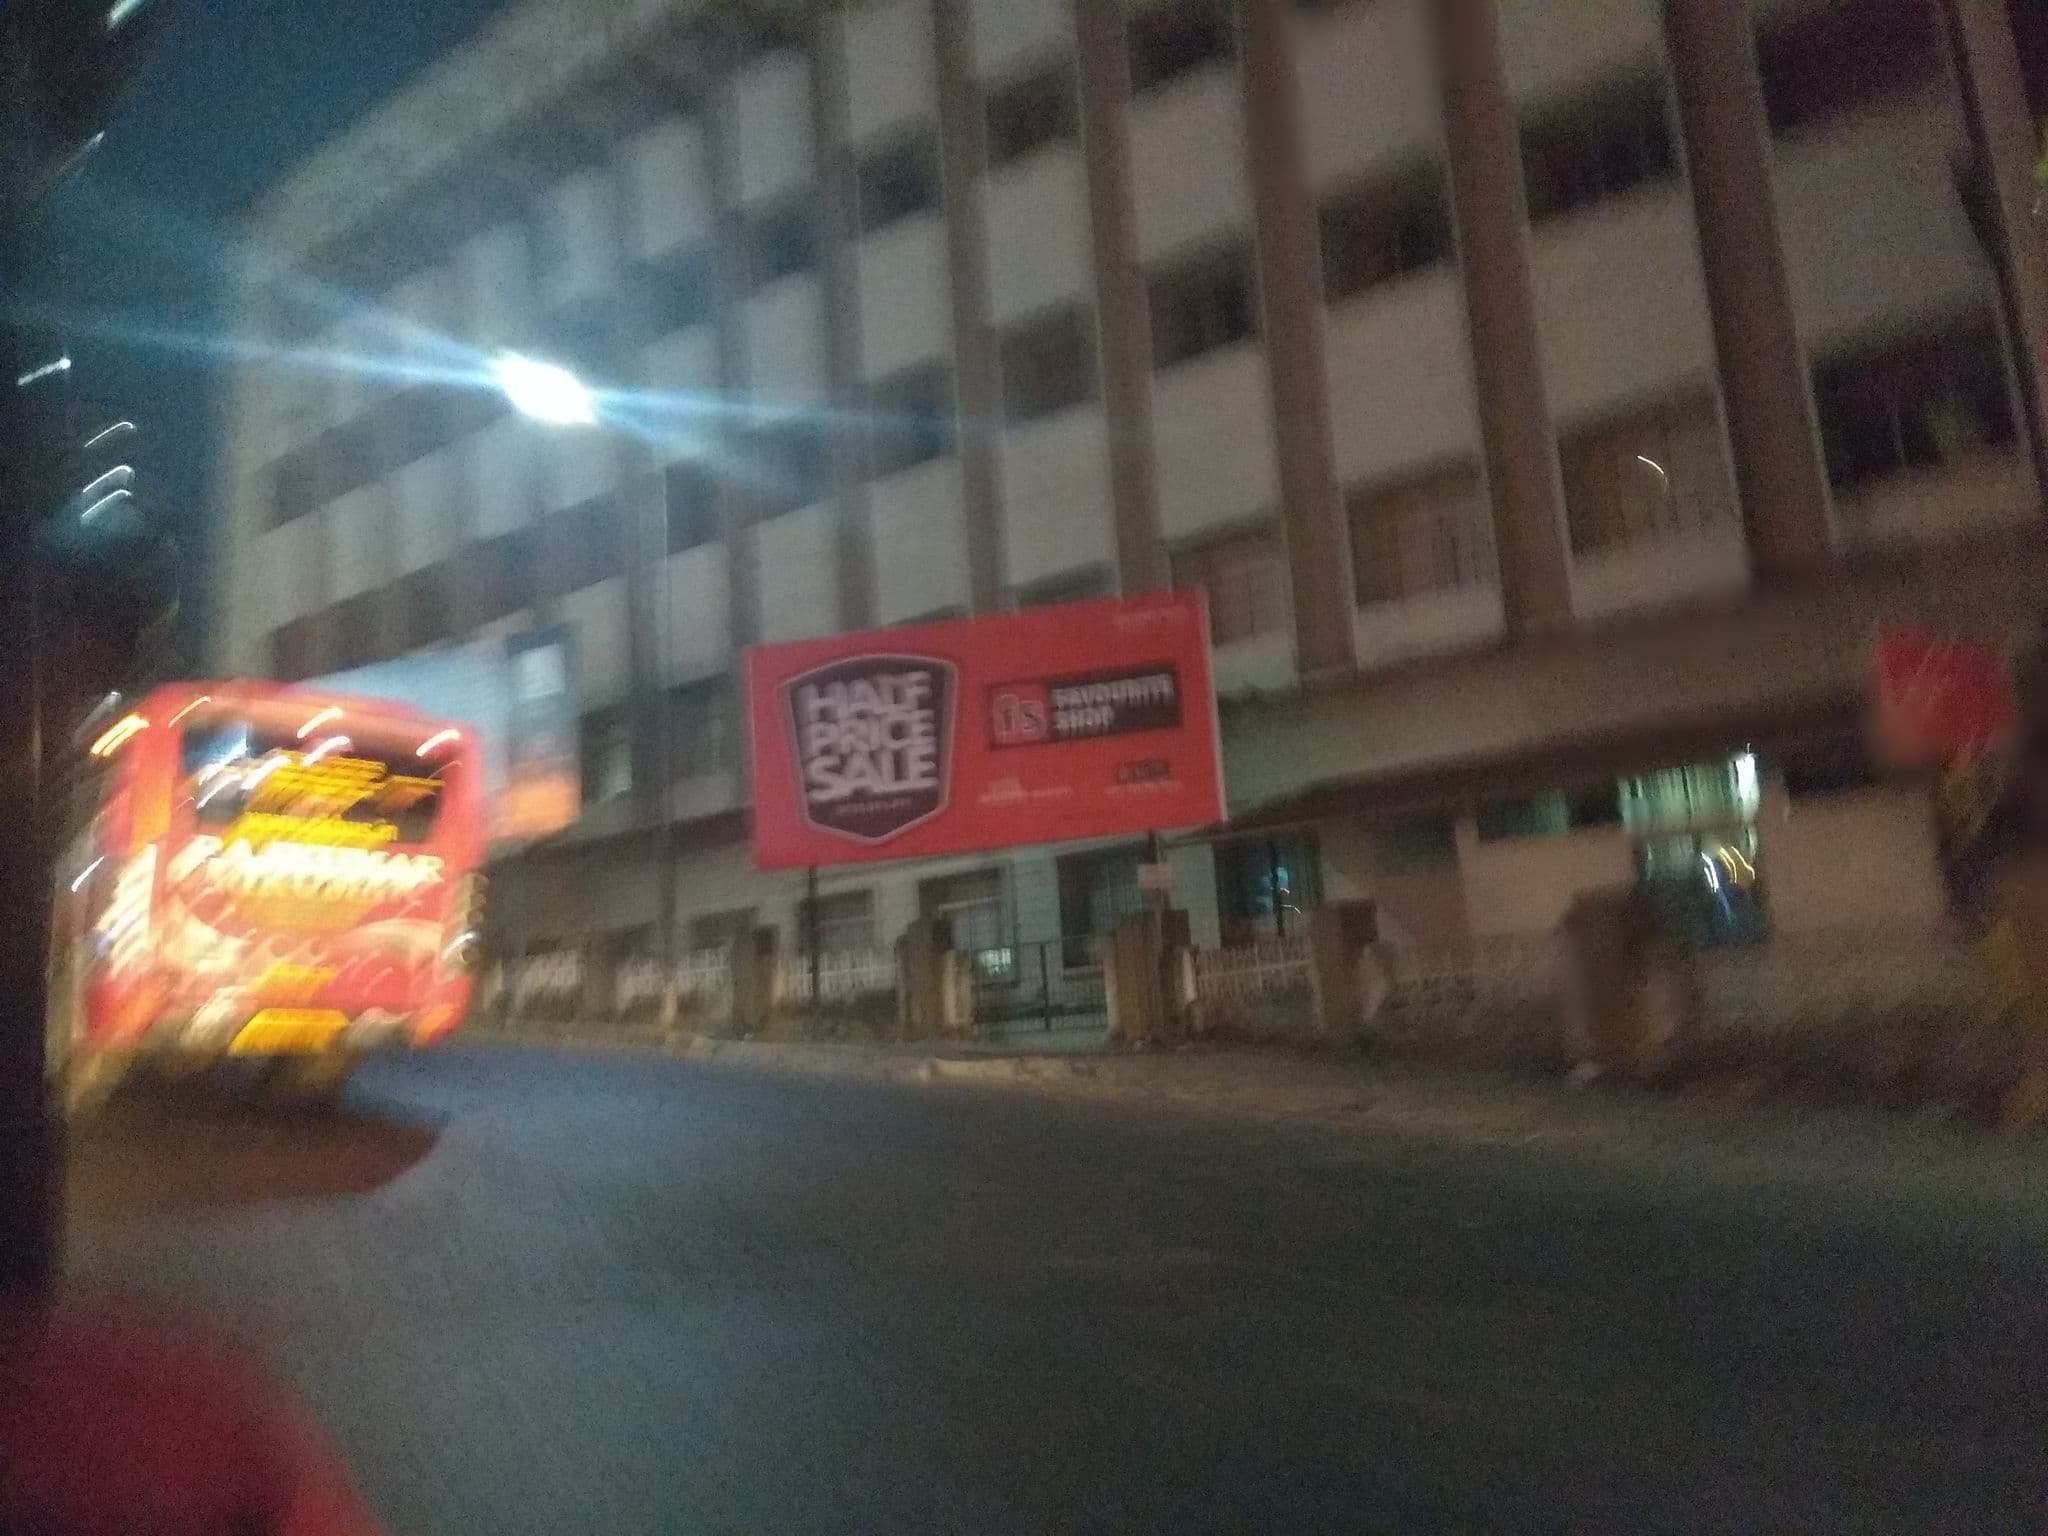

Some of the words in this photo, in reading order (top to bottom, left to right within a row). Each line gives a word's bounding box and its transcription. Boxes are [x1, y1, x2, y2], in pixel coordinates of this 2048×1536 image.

[797, 670, 933, 724] HALF
[801, 709, 937, 759] PRICE
[804, 746, 939, 802] SALE
